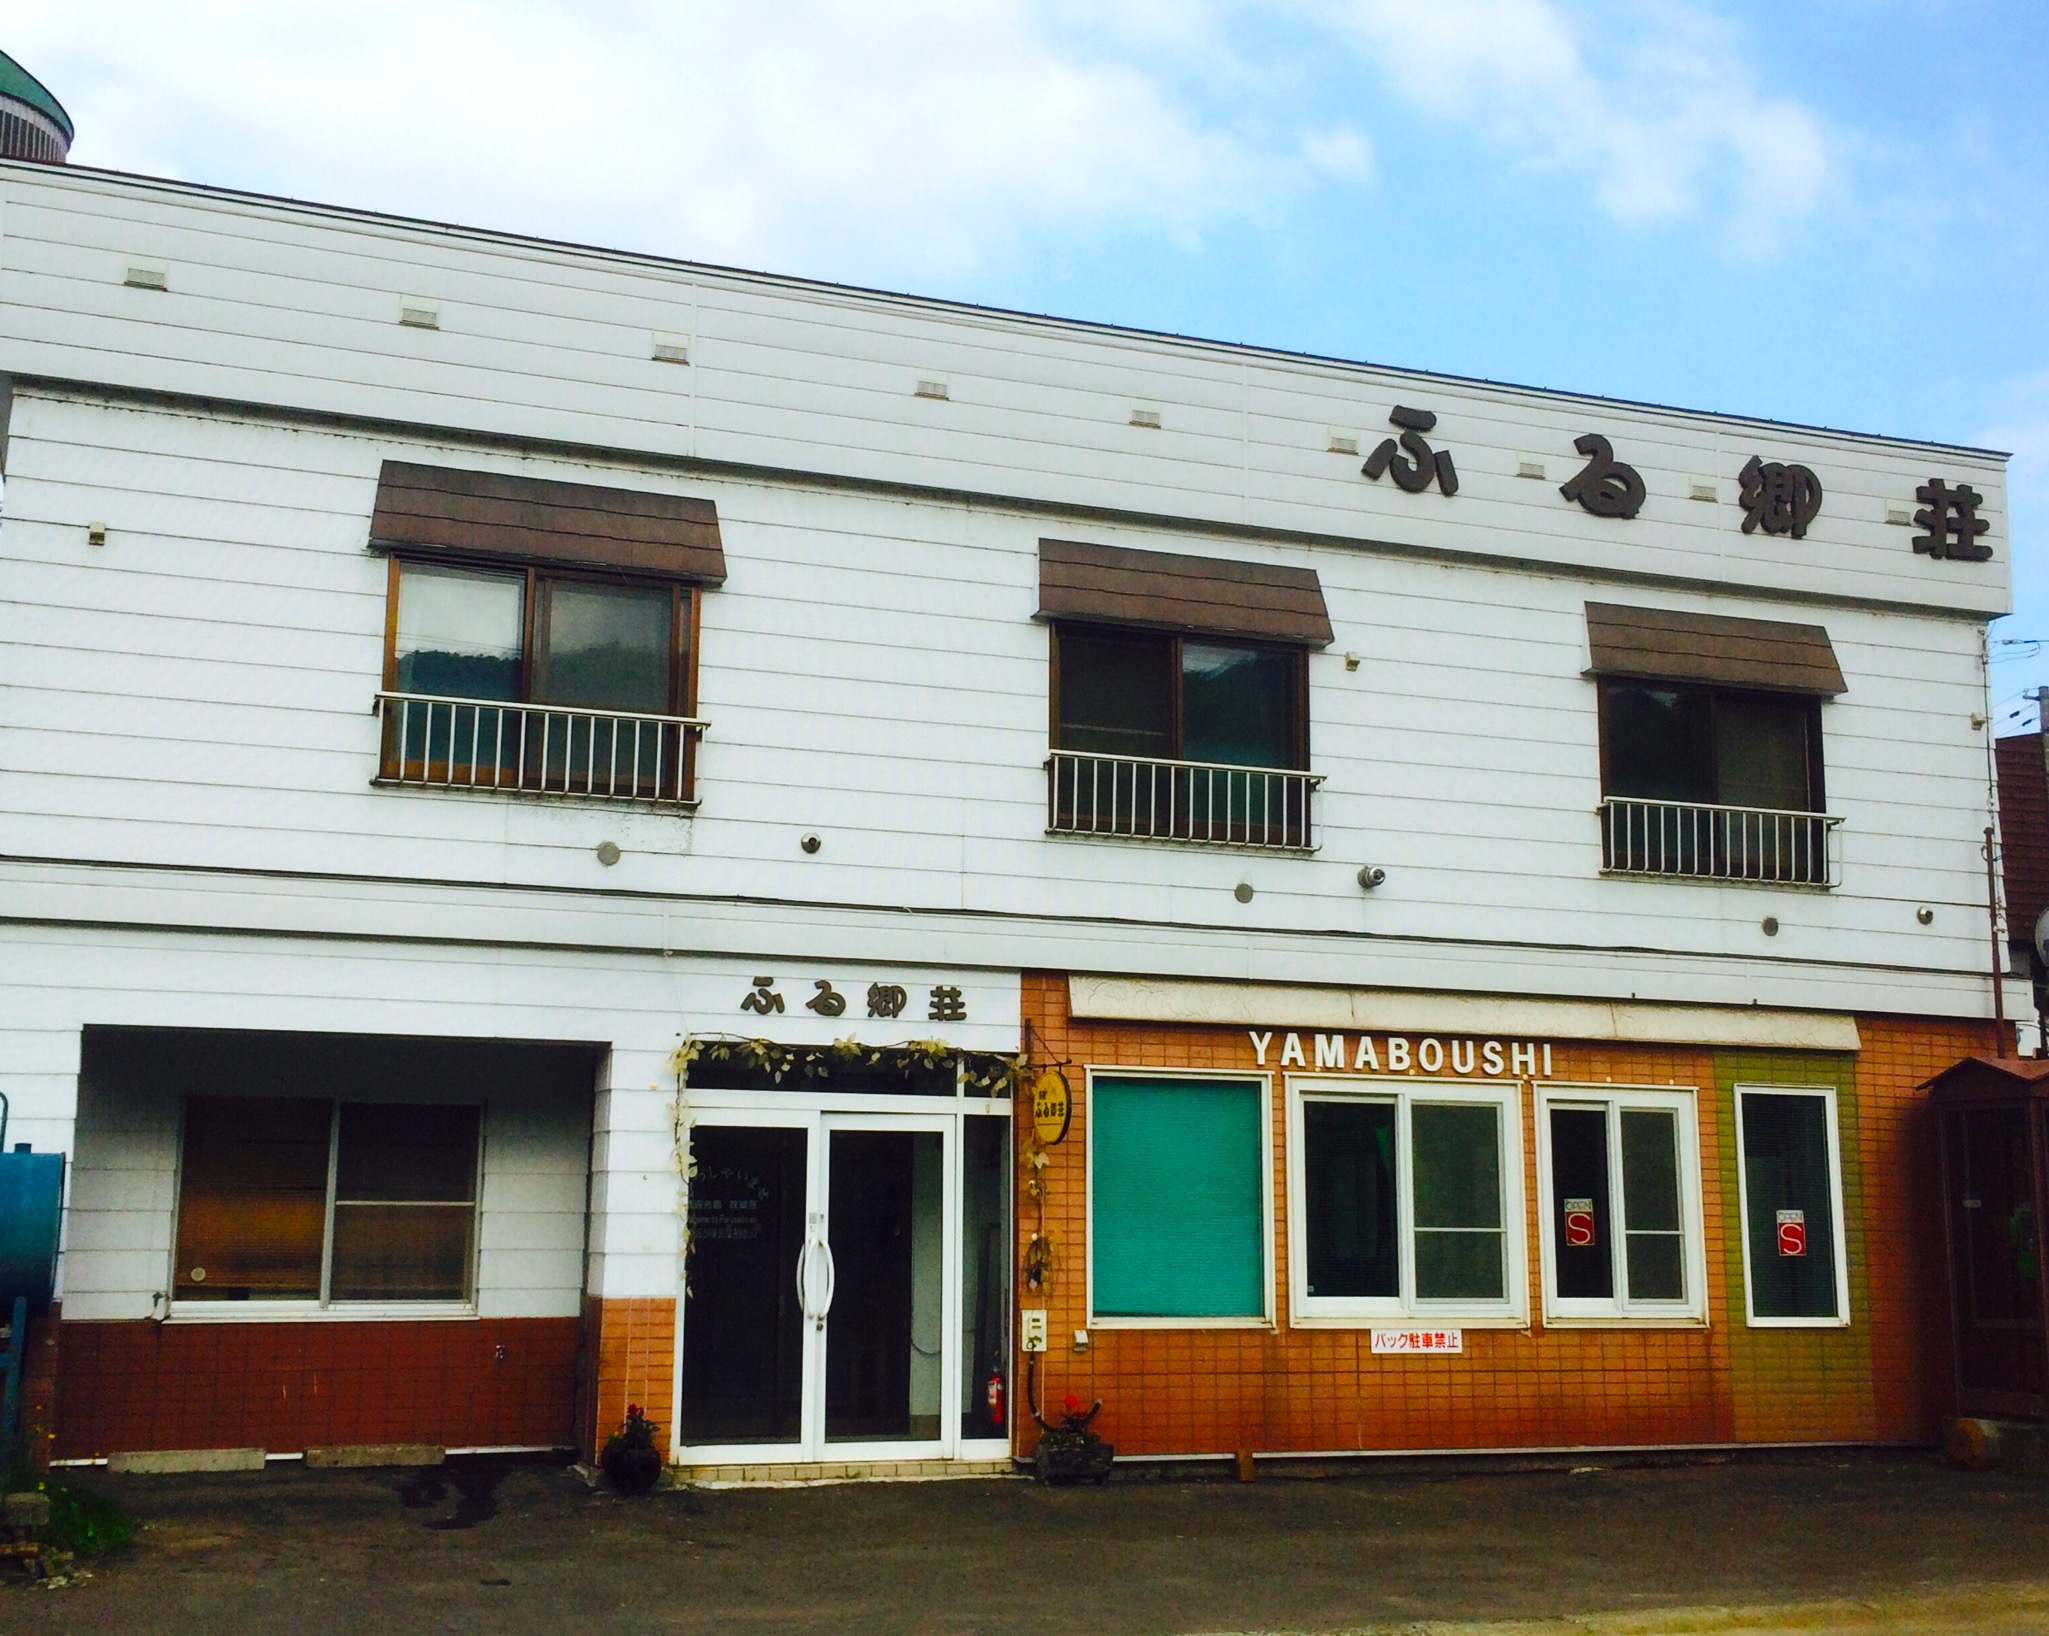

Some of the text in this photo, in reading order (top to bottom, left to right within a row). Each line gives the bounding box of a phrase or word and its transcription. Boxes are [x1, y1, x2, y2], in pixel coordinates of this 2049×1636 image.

[1361, 405, 1993, 561] ふる郷荘
[741, 976, 967, 1021] ふる郷荘
[1249, 1031, 1551, 1076] YAMABOUSHI
[1568, 1213, 1590, 1244] S
[1780, 1224, 1802, 1254] S
